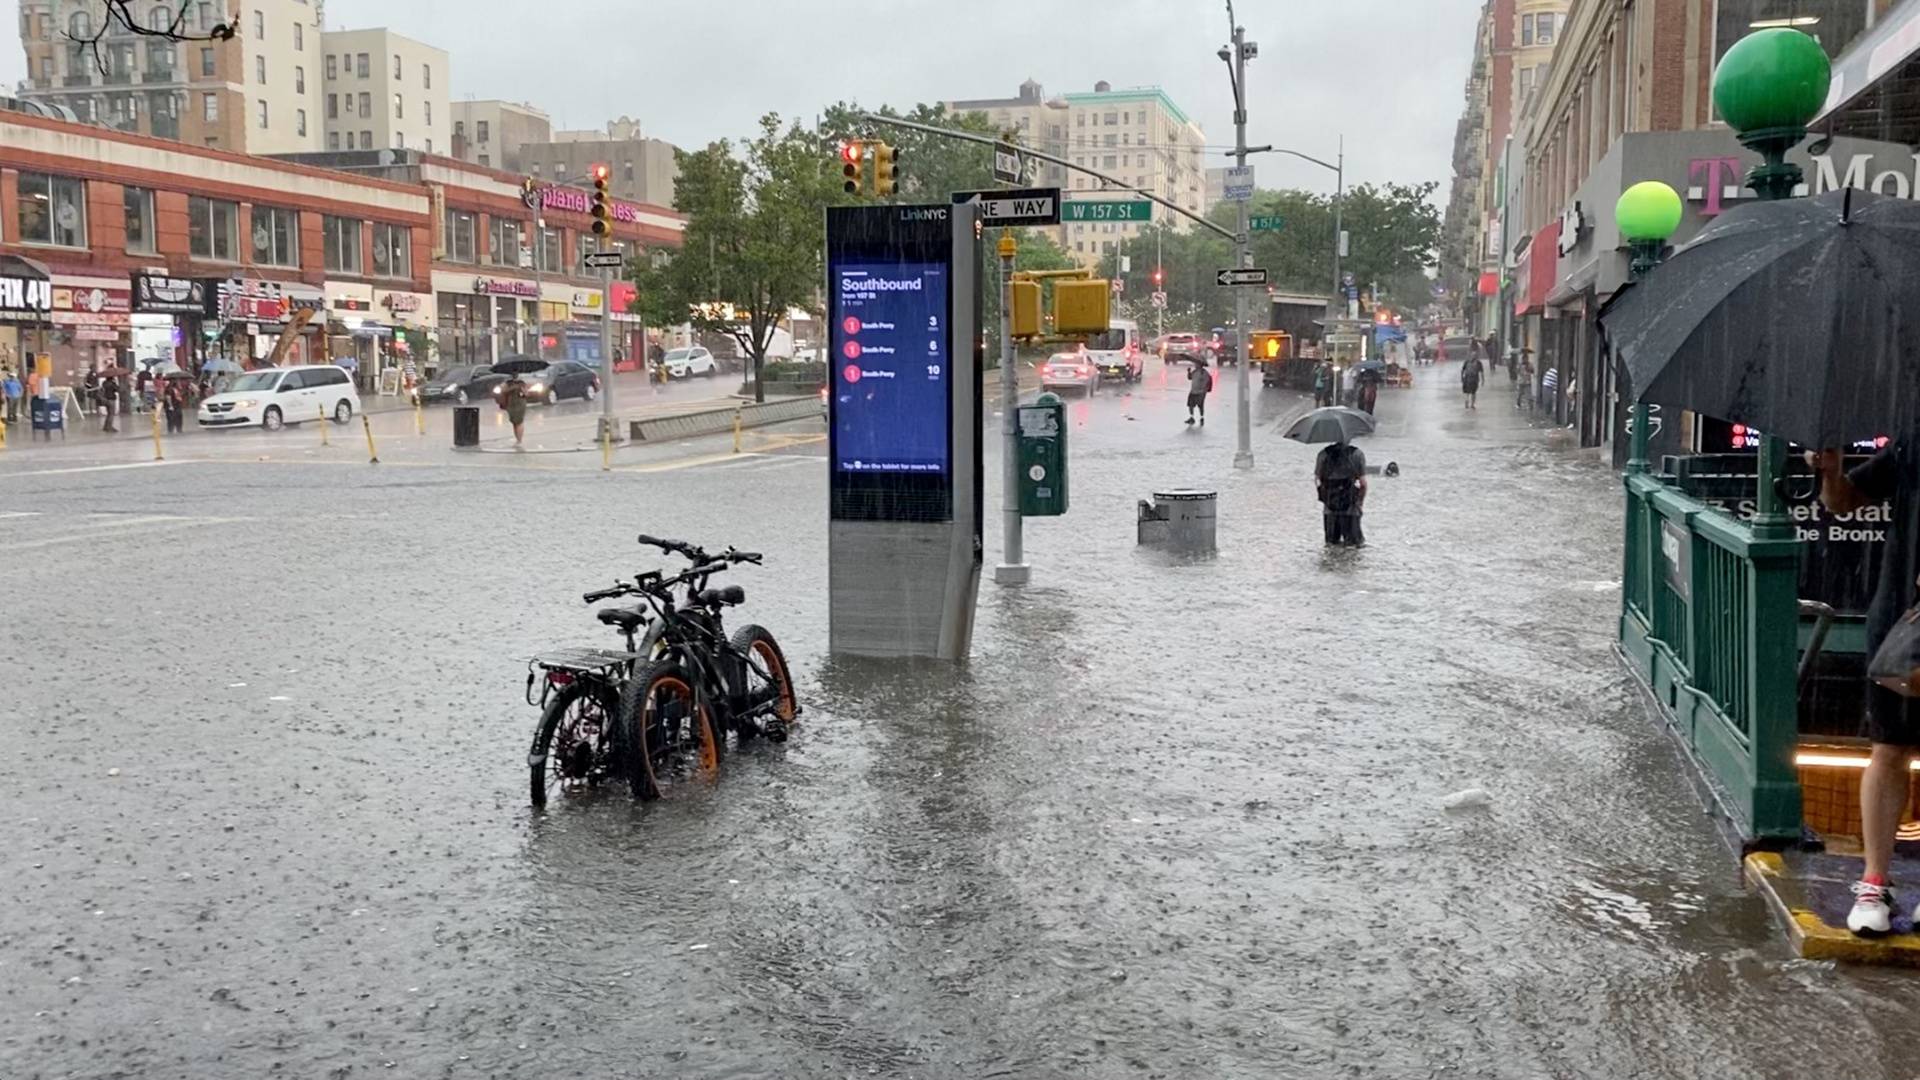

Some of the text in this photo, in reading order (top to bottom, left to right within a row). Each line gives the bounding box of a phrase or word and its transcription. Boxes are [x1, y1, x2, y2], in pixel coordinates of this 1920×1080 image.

[1811, 154, 1920, 200] Mo
[541, 183, 591, 213] planet
[900, 208, 948, 221] LinkNYC
[979, 200, 1046, 217] NE WAY
[1073, 201, 1132, 218] W 157 St
[841, 277, 922, 291] Southbound
[928, 316, 938, 327] 3
[929, 340, 938, 351] 6
[926, 365, 940, 375] 10
[1795, 525, 1886, 542] he Bronx
